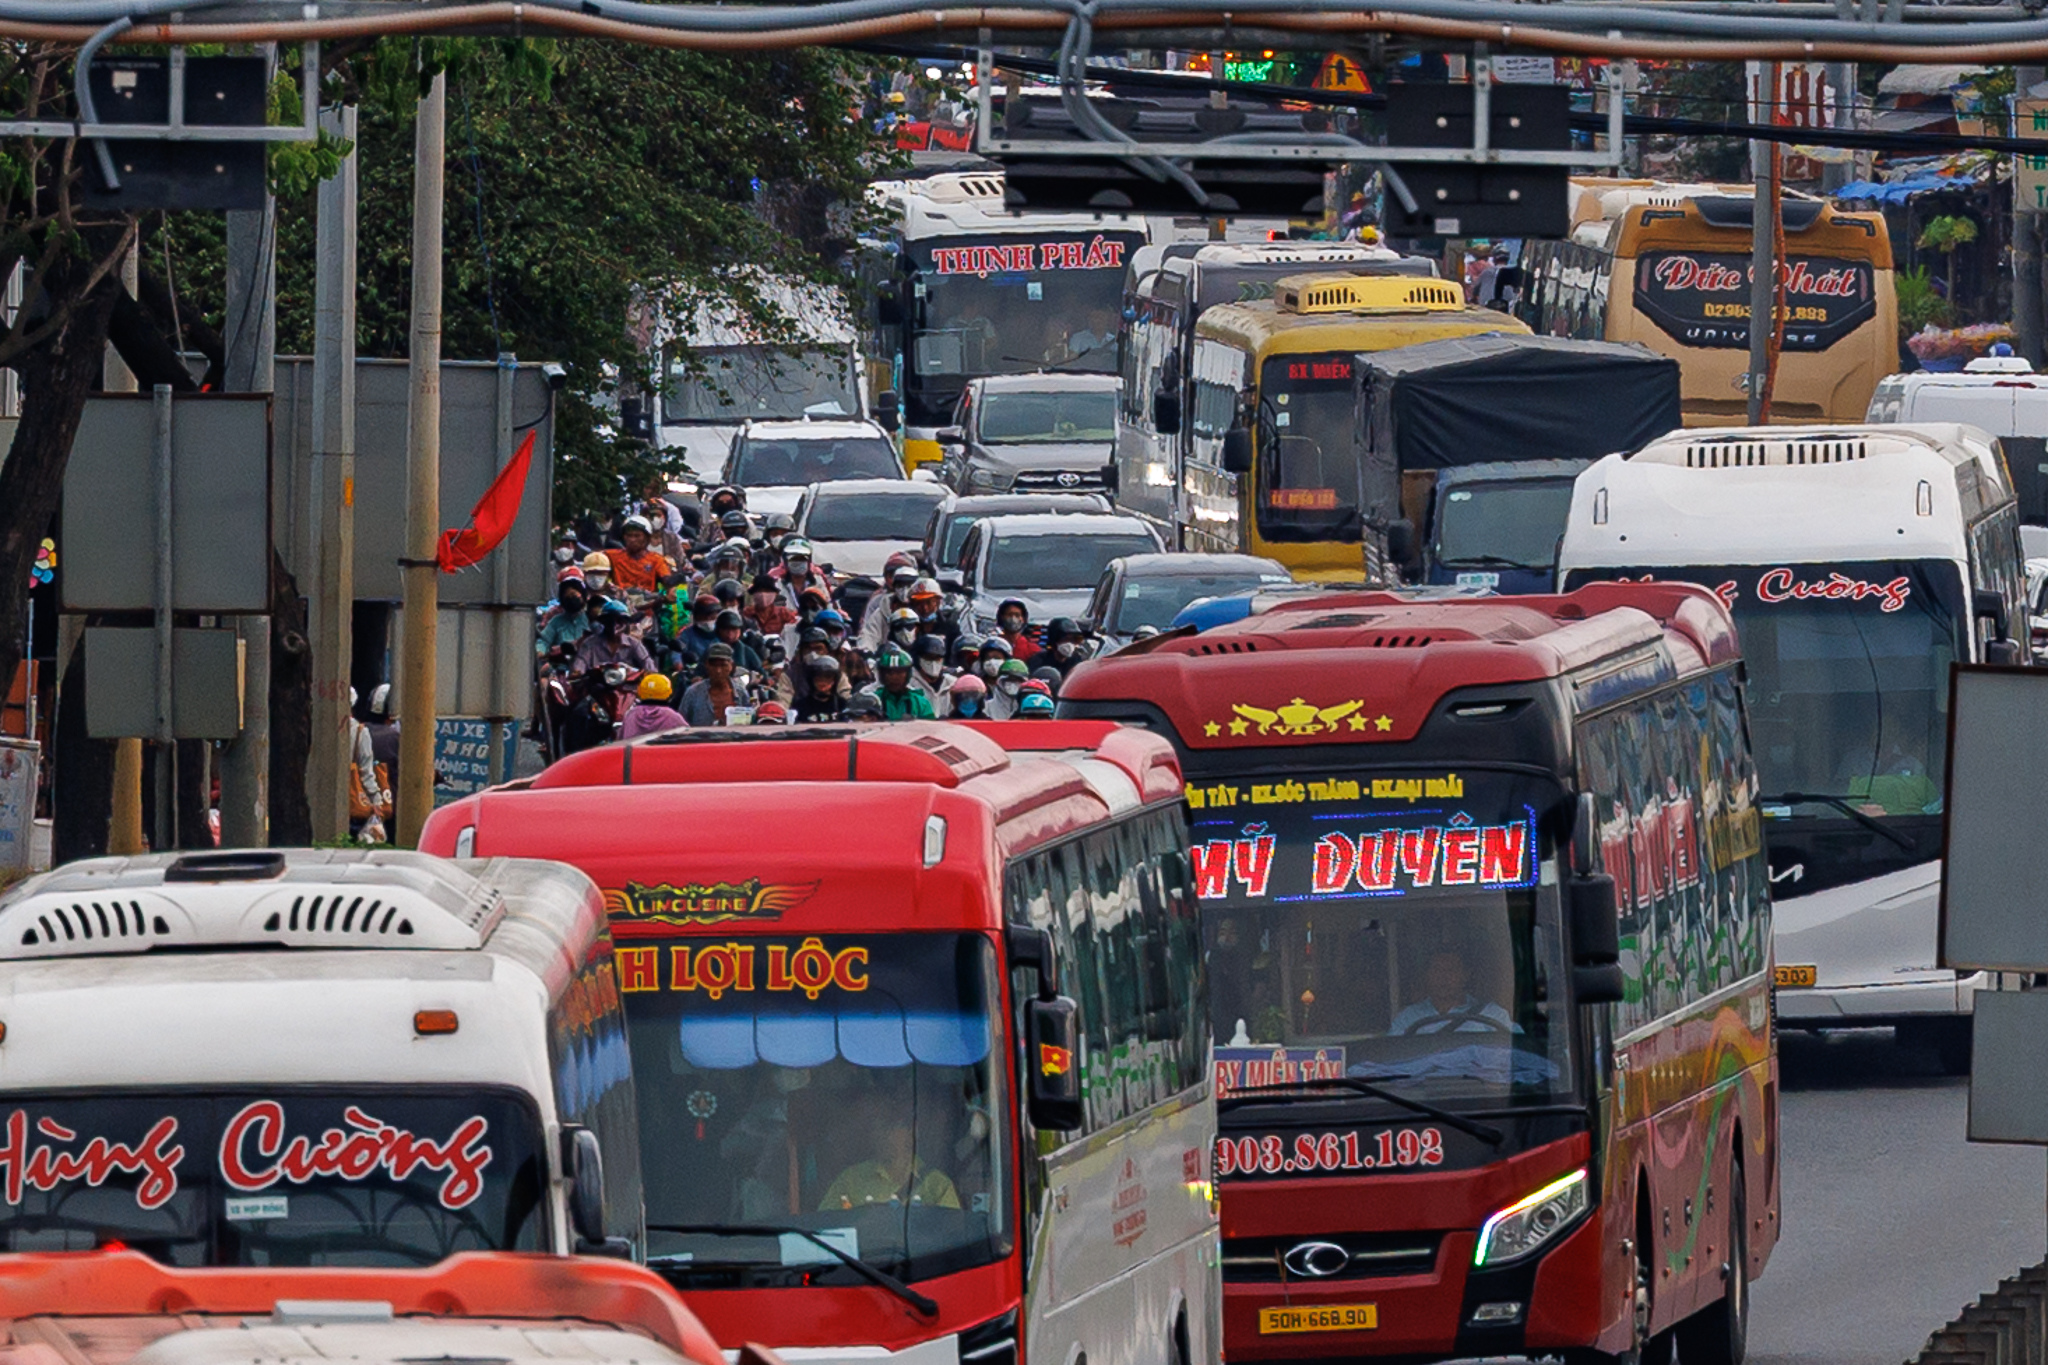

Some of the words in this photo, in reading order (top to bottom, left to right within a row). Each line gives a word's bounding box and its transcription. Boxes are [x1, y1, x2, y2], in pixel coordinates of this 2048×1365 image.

[932, 246, 1035, 279] THỊNH
[1040, 234, 1125, 271] PHÁT
[1756, 568, 1909, 612] Cường
[1272, 724, 1324, 736] VIP
[638, 896, 748, 914] LIMOUSINE
[670, 942, 755, 999] LỢI
[766, 937, 868, 999] LỘC
[220, 1100, 492, 1209] Cường
